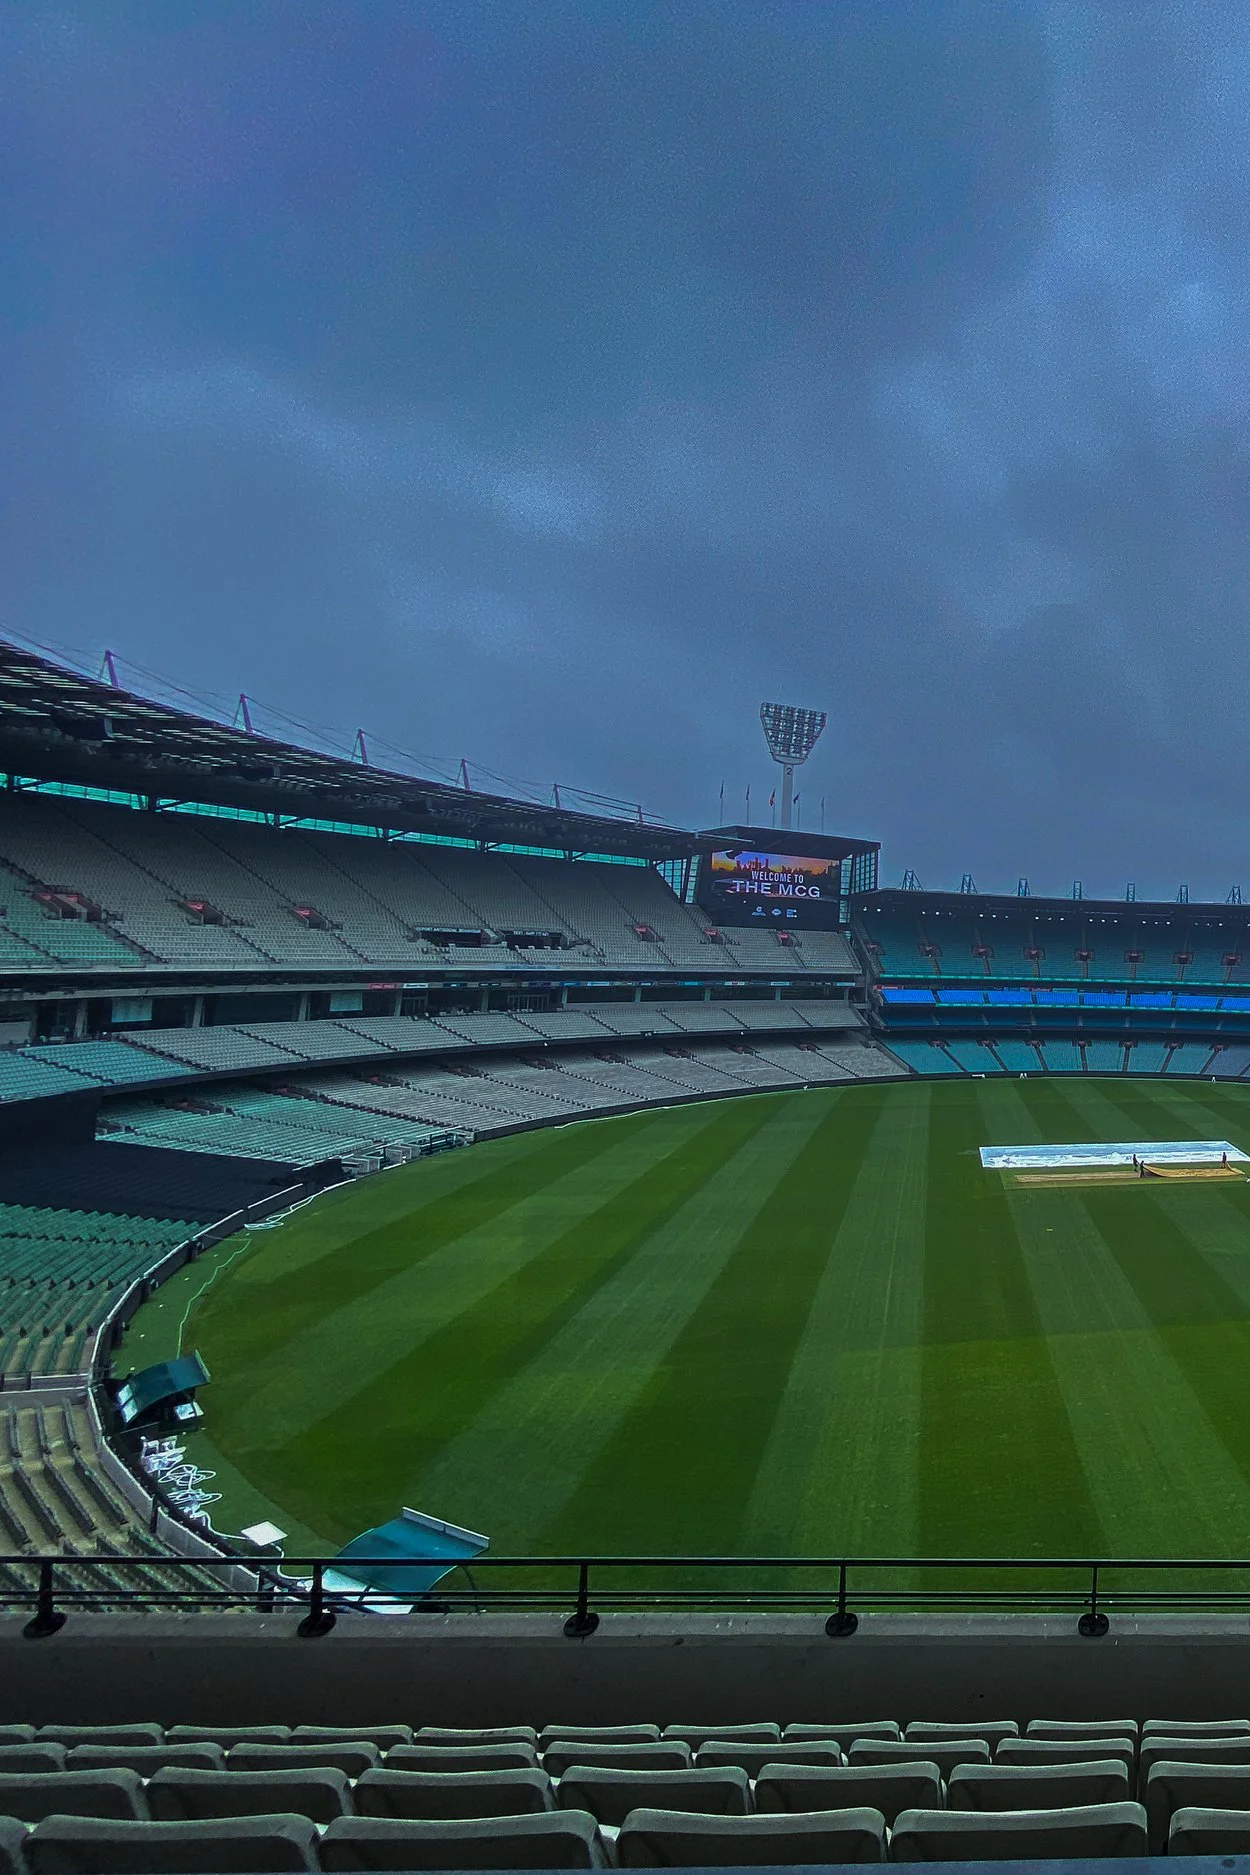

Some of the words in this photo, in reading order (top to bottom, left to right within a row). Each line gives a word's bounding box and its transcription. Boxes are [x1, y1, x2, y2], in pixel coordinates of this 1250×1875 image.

[786, 767, 792, 776] 2
[751, 870, 791, 883] WELCOME
[794, 874, 804, 884] TO
[732, 880, 772, 894] THE
[778, 883, 820, 898] MCG
